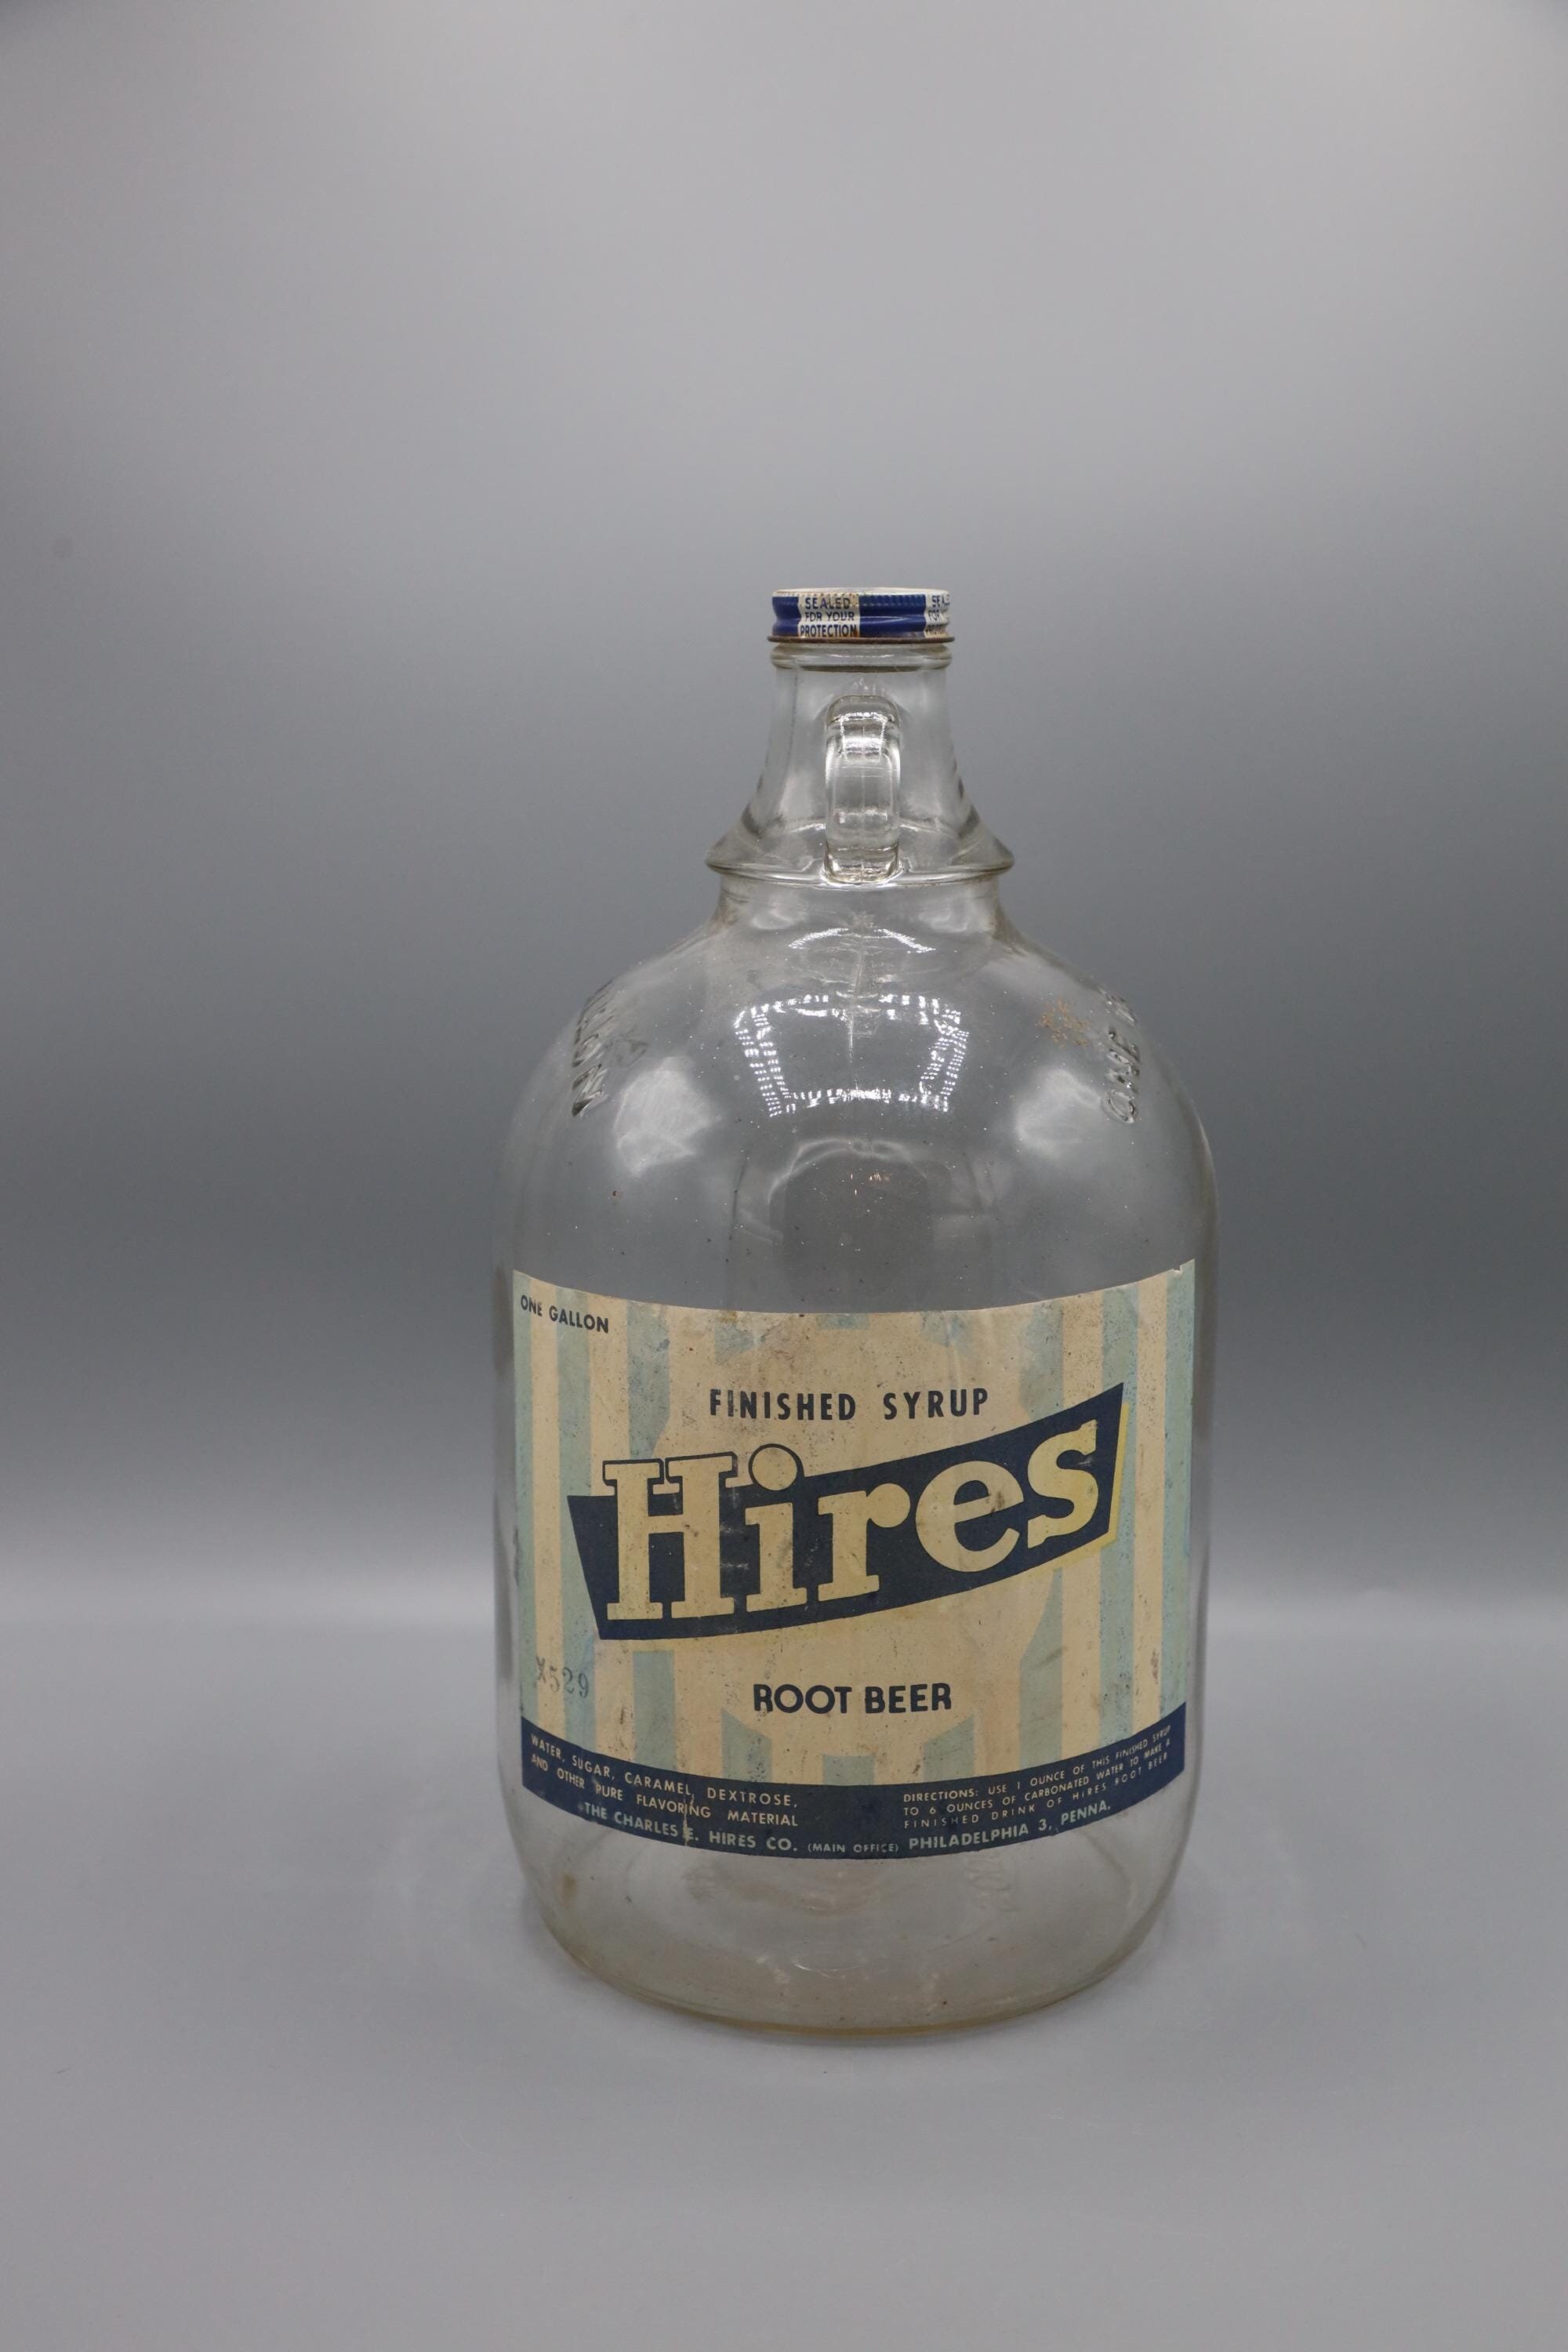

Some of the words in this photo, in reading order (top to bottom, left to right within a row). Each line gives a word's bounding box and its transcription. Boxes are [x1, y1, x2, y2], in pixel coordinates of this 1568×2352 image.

[804, 597, 851, 610] SEALED
[804, 612, 822, 622] FOR
[827, 611, 855, 622] YOUR
[800, 624, 858, 637] PROTECTION
[521, 1294, 543, 1317] ONE
[549, 1305, 609, 1333] GALLON
[710, 1388, 856, 1421] FINISHED
[883, 1388, 988, 1420] SYRUP
[602, 1418, 1099, 1621] Hires
[753, 1686, 854, 1714] ROOT
[865, 1683, 953, 1714] BEER
[531, 1733, 565, 1763] WATER,
[572, 1755, 615, 1780] SUGAR,
[624, 1772, 695, 1806] CARAMEL,
[707, 1788, 797, 1809] DEXTROSE,
[532, 1754, 548, 1771] AND
[557, 1768, 585, 1789] OTHER
[595, 1784, 623, 1801] PURE
[637, 1794, 711, 1818] FLAVORING
[728, 1809, 799, 1827] MATERIAL
[903, 1788, 978, 1802] DIRECTIONS:
[988, 1784, 1007, 1795] USE
[1030, 1770, 1065, 1787] OUNCE
[1073, 1764, 1085, 1775] OF
[1092, 1755, 1110, 1769] THIS
[1116, 1739, 1148, 1759] FINISHED
[903, 1806, 919, 1816] TO
[929, 1806, 936, 1815] 6
[946, 1799, 993, 1813] OUNCES
[1002, 1795, 1016, 1806] OF
[1024, 1776, 1089, 1801] CARBONATED
[1096, 1762, 1123, 1780] WATER
[1130, 1756, 1139, 1767] TO
[1144, 1743, 1162, 1759] MAKE
[904, 1814, 979, 1829] FINISHED
[991, 1804, 1035, 1820] DRINK
[1047, 1797, 1062, 1808] OF
[1073, 1782, 1106, 1800] HIRES
[1115, 1766, 1142, 1786] ROOT
[584, 1802, 608, 1820] THE
[614, 1811, 678, 1837] CHARLES
[709, 1831, 756, 1848] HIRES
[766, 1836, 797, 1851] CO.
[808, 1842, 845, 1853] (MAIN
[853, 1842, 898, 1853] OFFICE)
[909, 1823, 1029, 1849] PHILADELPHIA
[1038, 1818, 1052, 1831] 3,
[1061, 1800, 1111, 1825] PENNA.
